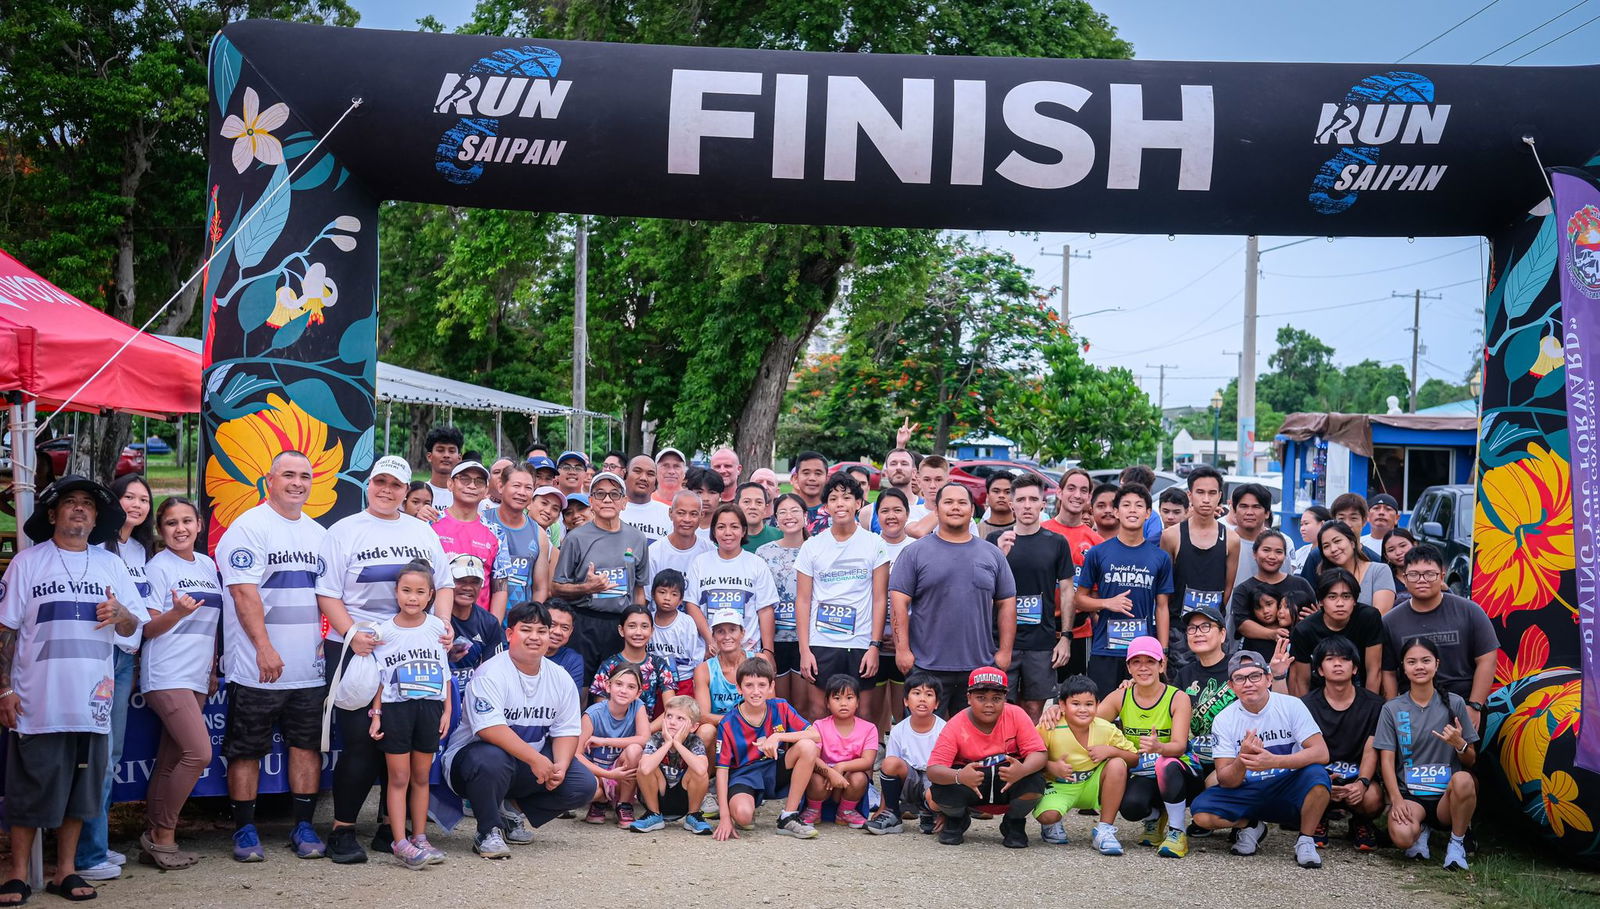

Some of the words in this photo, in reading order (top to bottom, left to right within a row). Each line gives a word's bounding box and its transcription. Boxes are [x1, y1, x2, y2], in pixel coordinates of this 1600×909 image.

[433, 73, 572, 119] RUN
[668, 68, 1214, 190] FINISH
[1313, 102, 1451, 145] RUN
[457, 135, 567, 166] SAIPAN
[1334, 165, 1447, 191] SAIPAN
[267, 550, 292, 565] Ride
[357, 547, 388, 561] Ride
[390, 546, 423, 559] With
[819, 568, 868, 578] SKECHERS
[1110, 563, 1130, 573] Project
[718, 577, 742, 585] With
[1104, 572, 1154, 586] SAIPAN
[32, 581, 66, 598] Ride
[68, 581, 104, 596] With
[711, 591, 742, 602] 2286
[1016, 597, 1038, 608] 269
[1191, 591, 1218, 604] 1154
[822, 605, 852, 617] 2282
[1113, 620, 1142, 632] 2281
[385, 652, 407, 667] Ride
[408, 648, 433, 660] With
[405, 663, 439, 675] 1115
[1196, 697, 1217, 718] TOUR
[1279, 729, 1292, 739] Us
[1411, 766, 1446, 777] 2264
